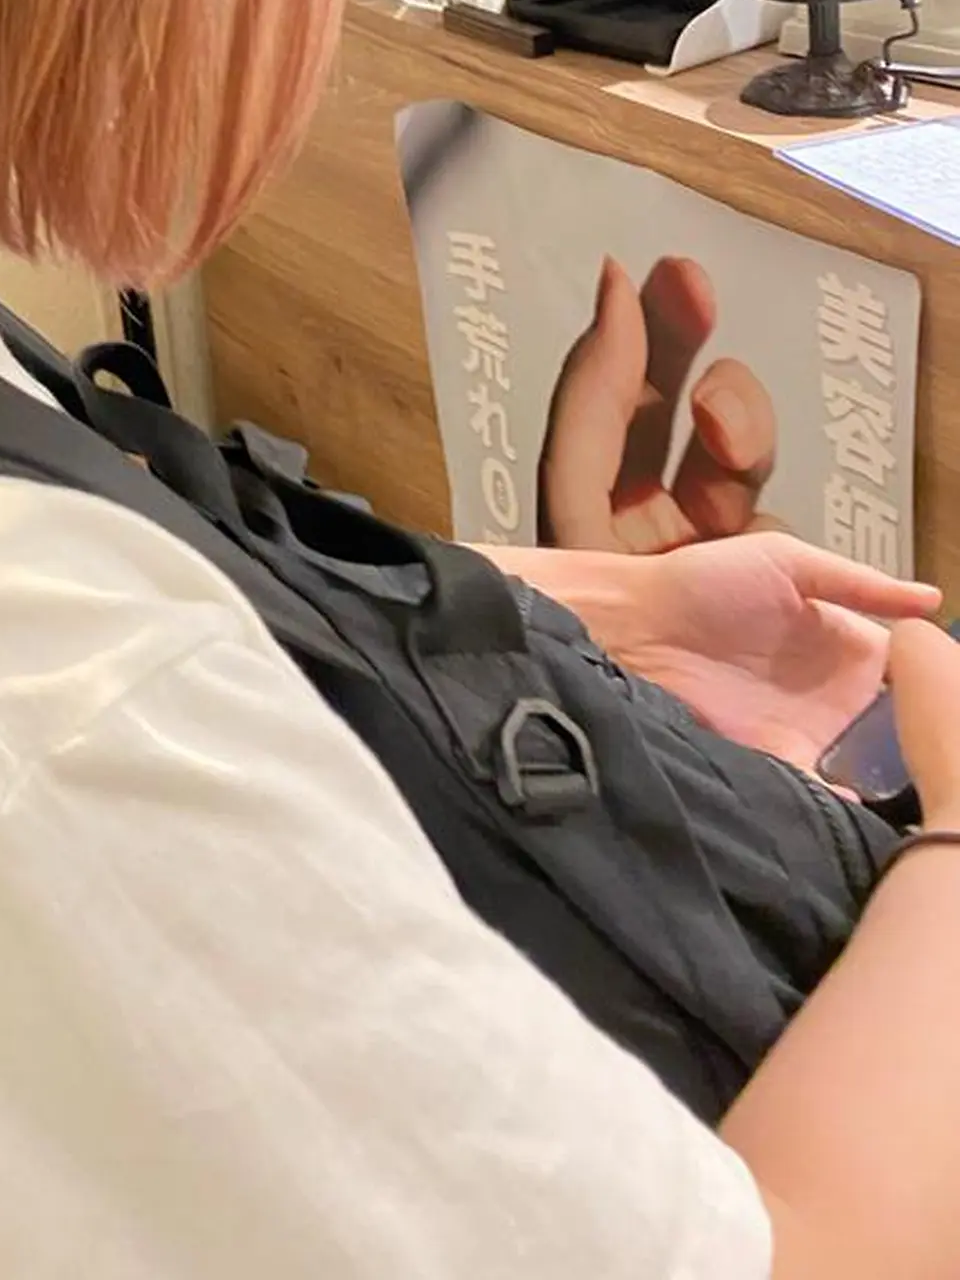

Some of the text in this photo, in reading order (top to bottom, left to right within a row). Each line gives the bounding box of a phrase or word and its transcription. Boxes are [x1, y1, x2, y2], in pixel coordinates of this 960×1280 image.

[445, 228, 521, 546] 手荒れ0
[815, 271, 901, 580] 美容師
